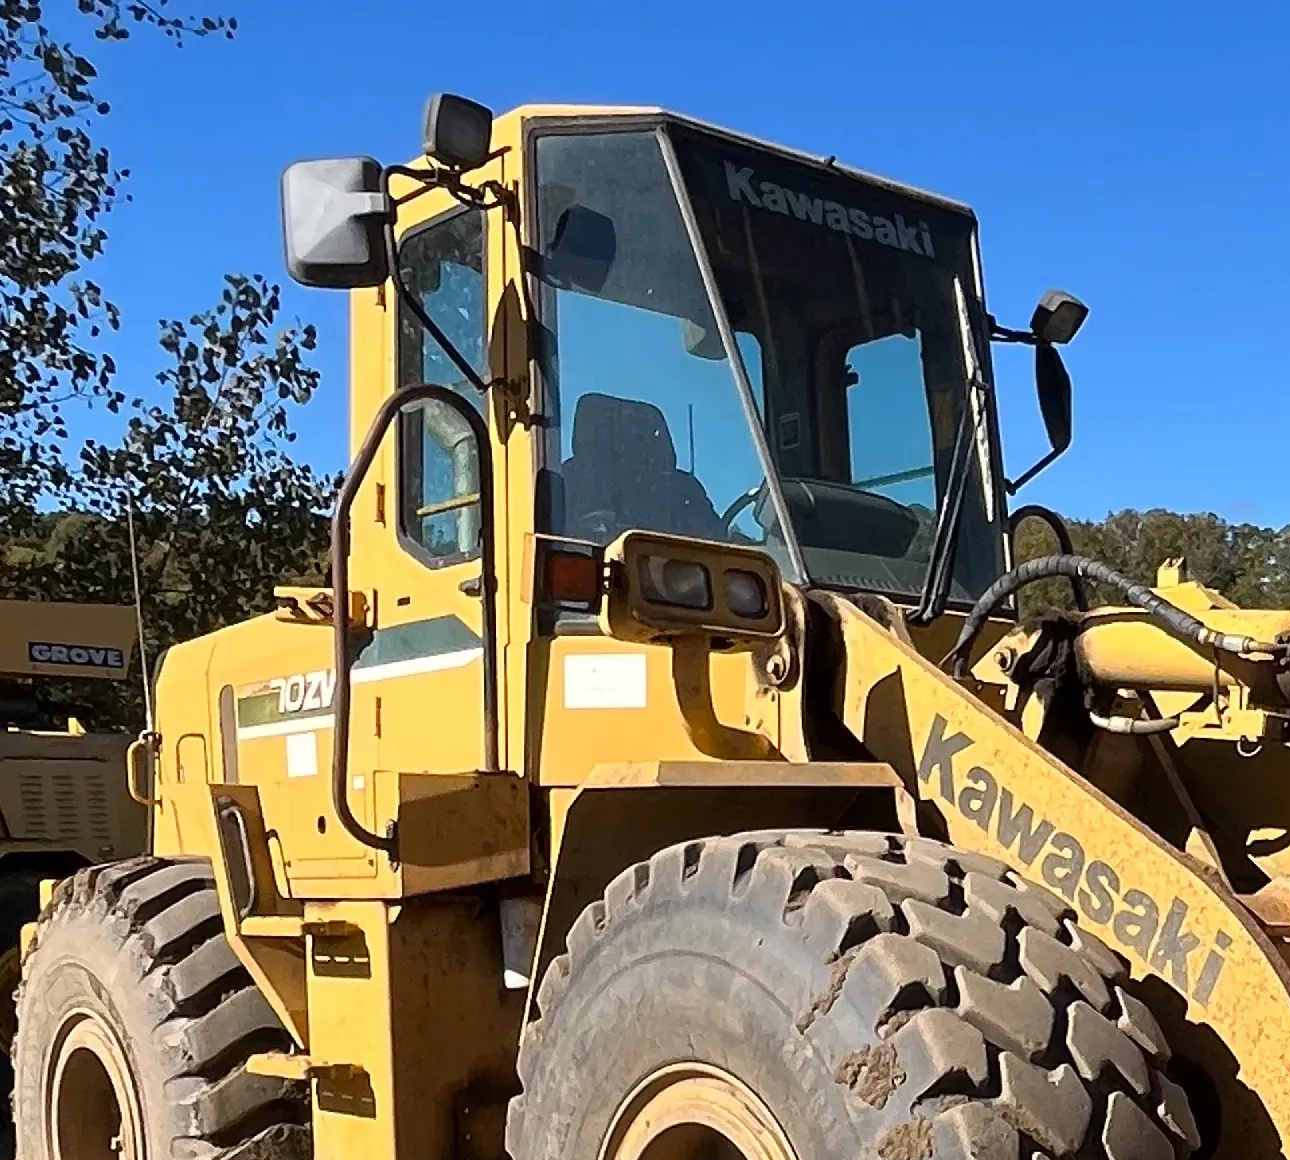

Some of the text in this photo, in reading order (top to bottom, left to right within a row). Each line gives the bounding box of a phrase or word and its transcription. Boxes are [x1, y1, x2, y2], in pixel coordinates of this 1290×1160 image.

[724, 159, 935, 259] Kawasaki
[31, 644, 122, 667] GROVE
[917, 713, 1233, 1005] Kawasaki
